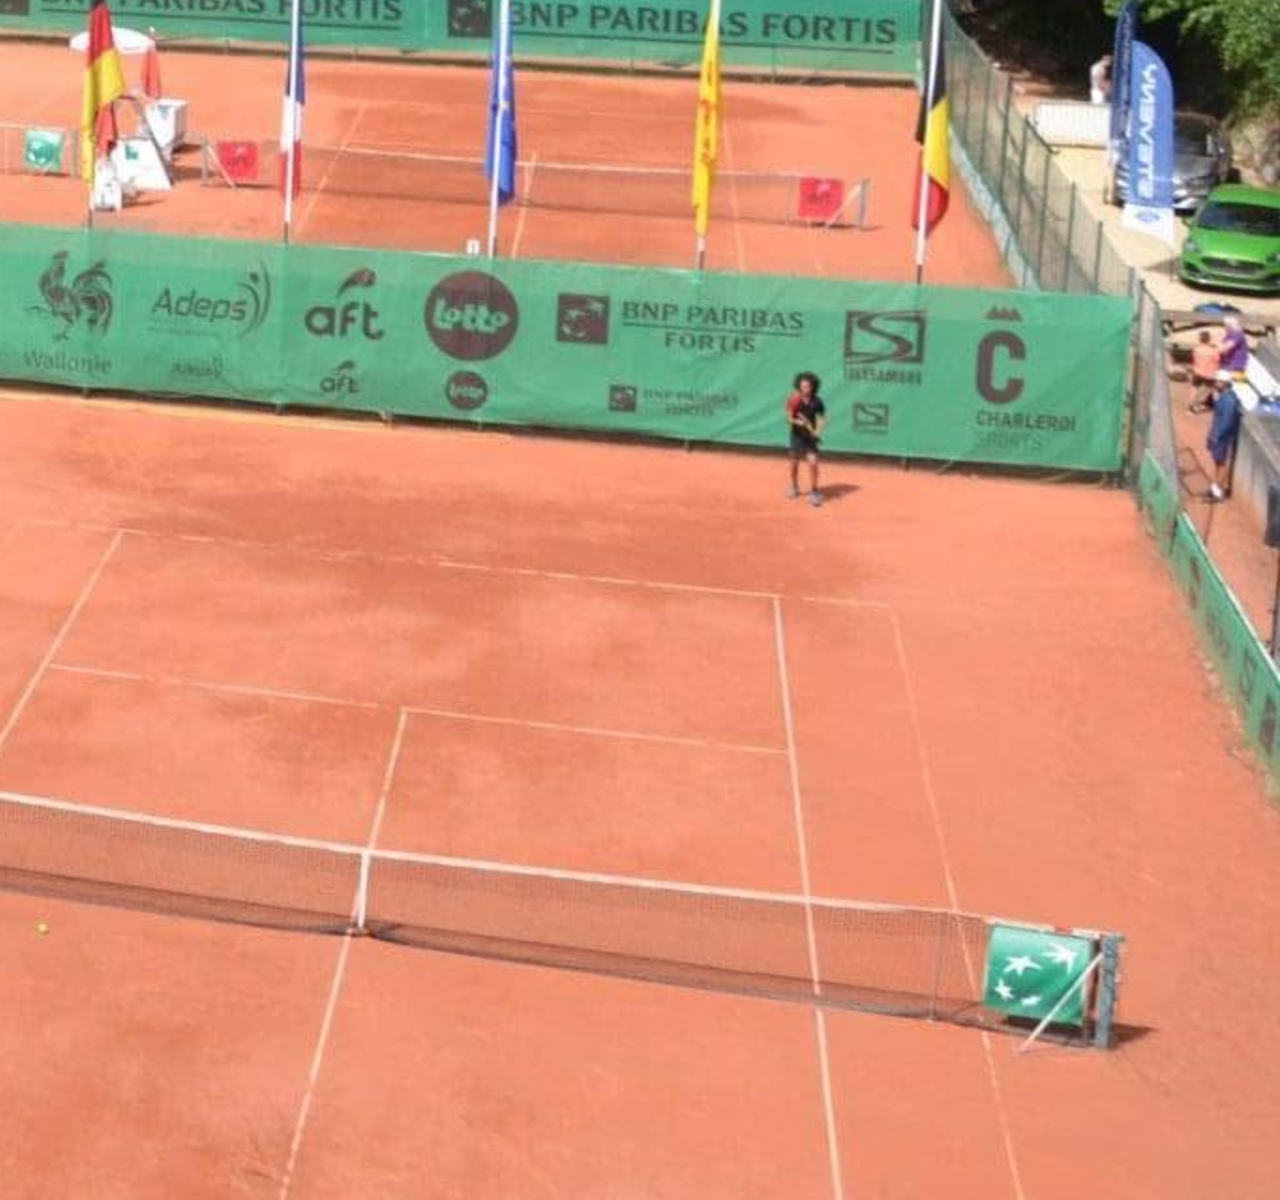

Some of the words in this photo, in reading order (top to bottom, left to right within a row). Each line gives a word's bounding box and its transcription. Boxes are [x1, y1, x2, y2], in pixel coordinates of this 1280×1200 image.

[762, 12, 897, 44] FORTIS
[151, 287, 248, 323] Adeps
[304, 300, 385, 341] aft
[622, 300, 680, 324] BNP
[686, 305, 804, 331] PARIBAS
[664, 331, 756, 355] FORTIS
